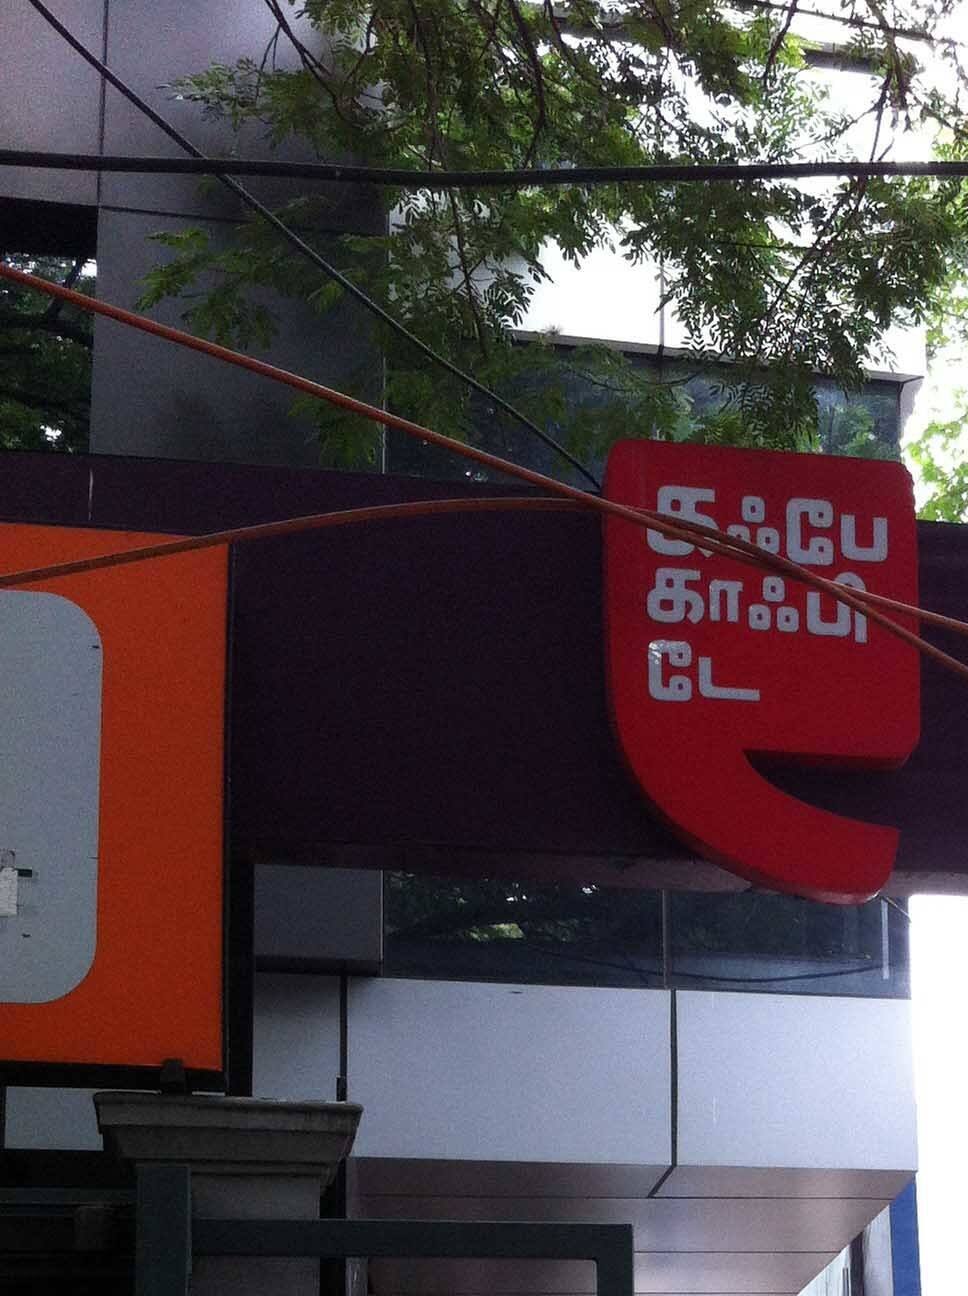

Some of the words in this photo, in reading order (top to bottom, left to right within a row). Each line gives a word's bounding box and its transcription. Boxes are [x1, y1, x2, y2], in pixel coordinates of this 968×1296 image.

[646, 485, 888, 566] கஃபே
[646, 567, 868, 643] காஃபி
[648, 640, 761, 701] டே
